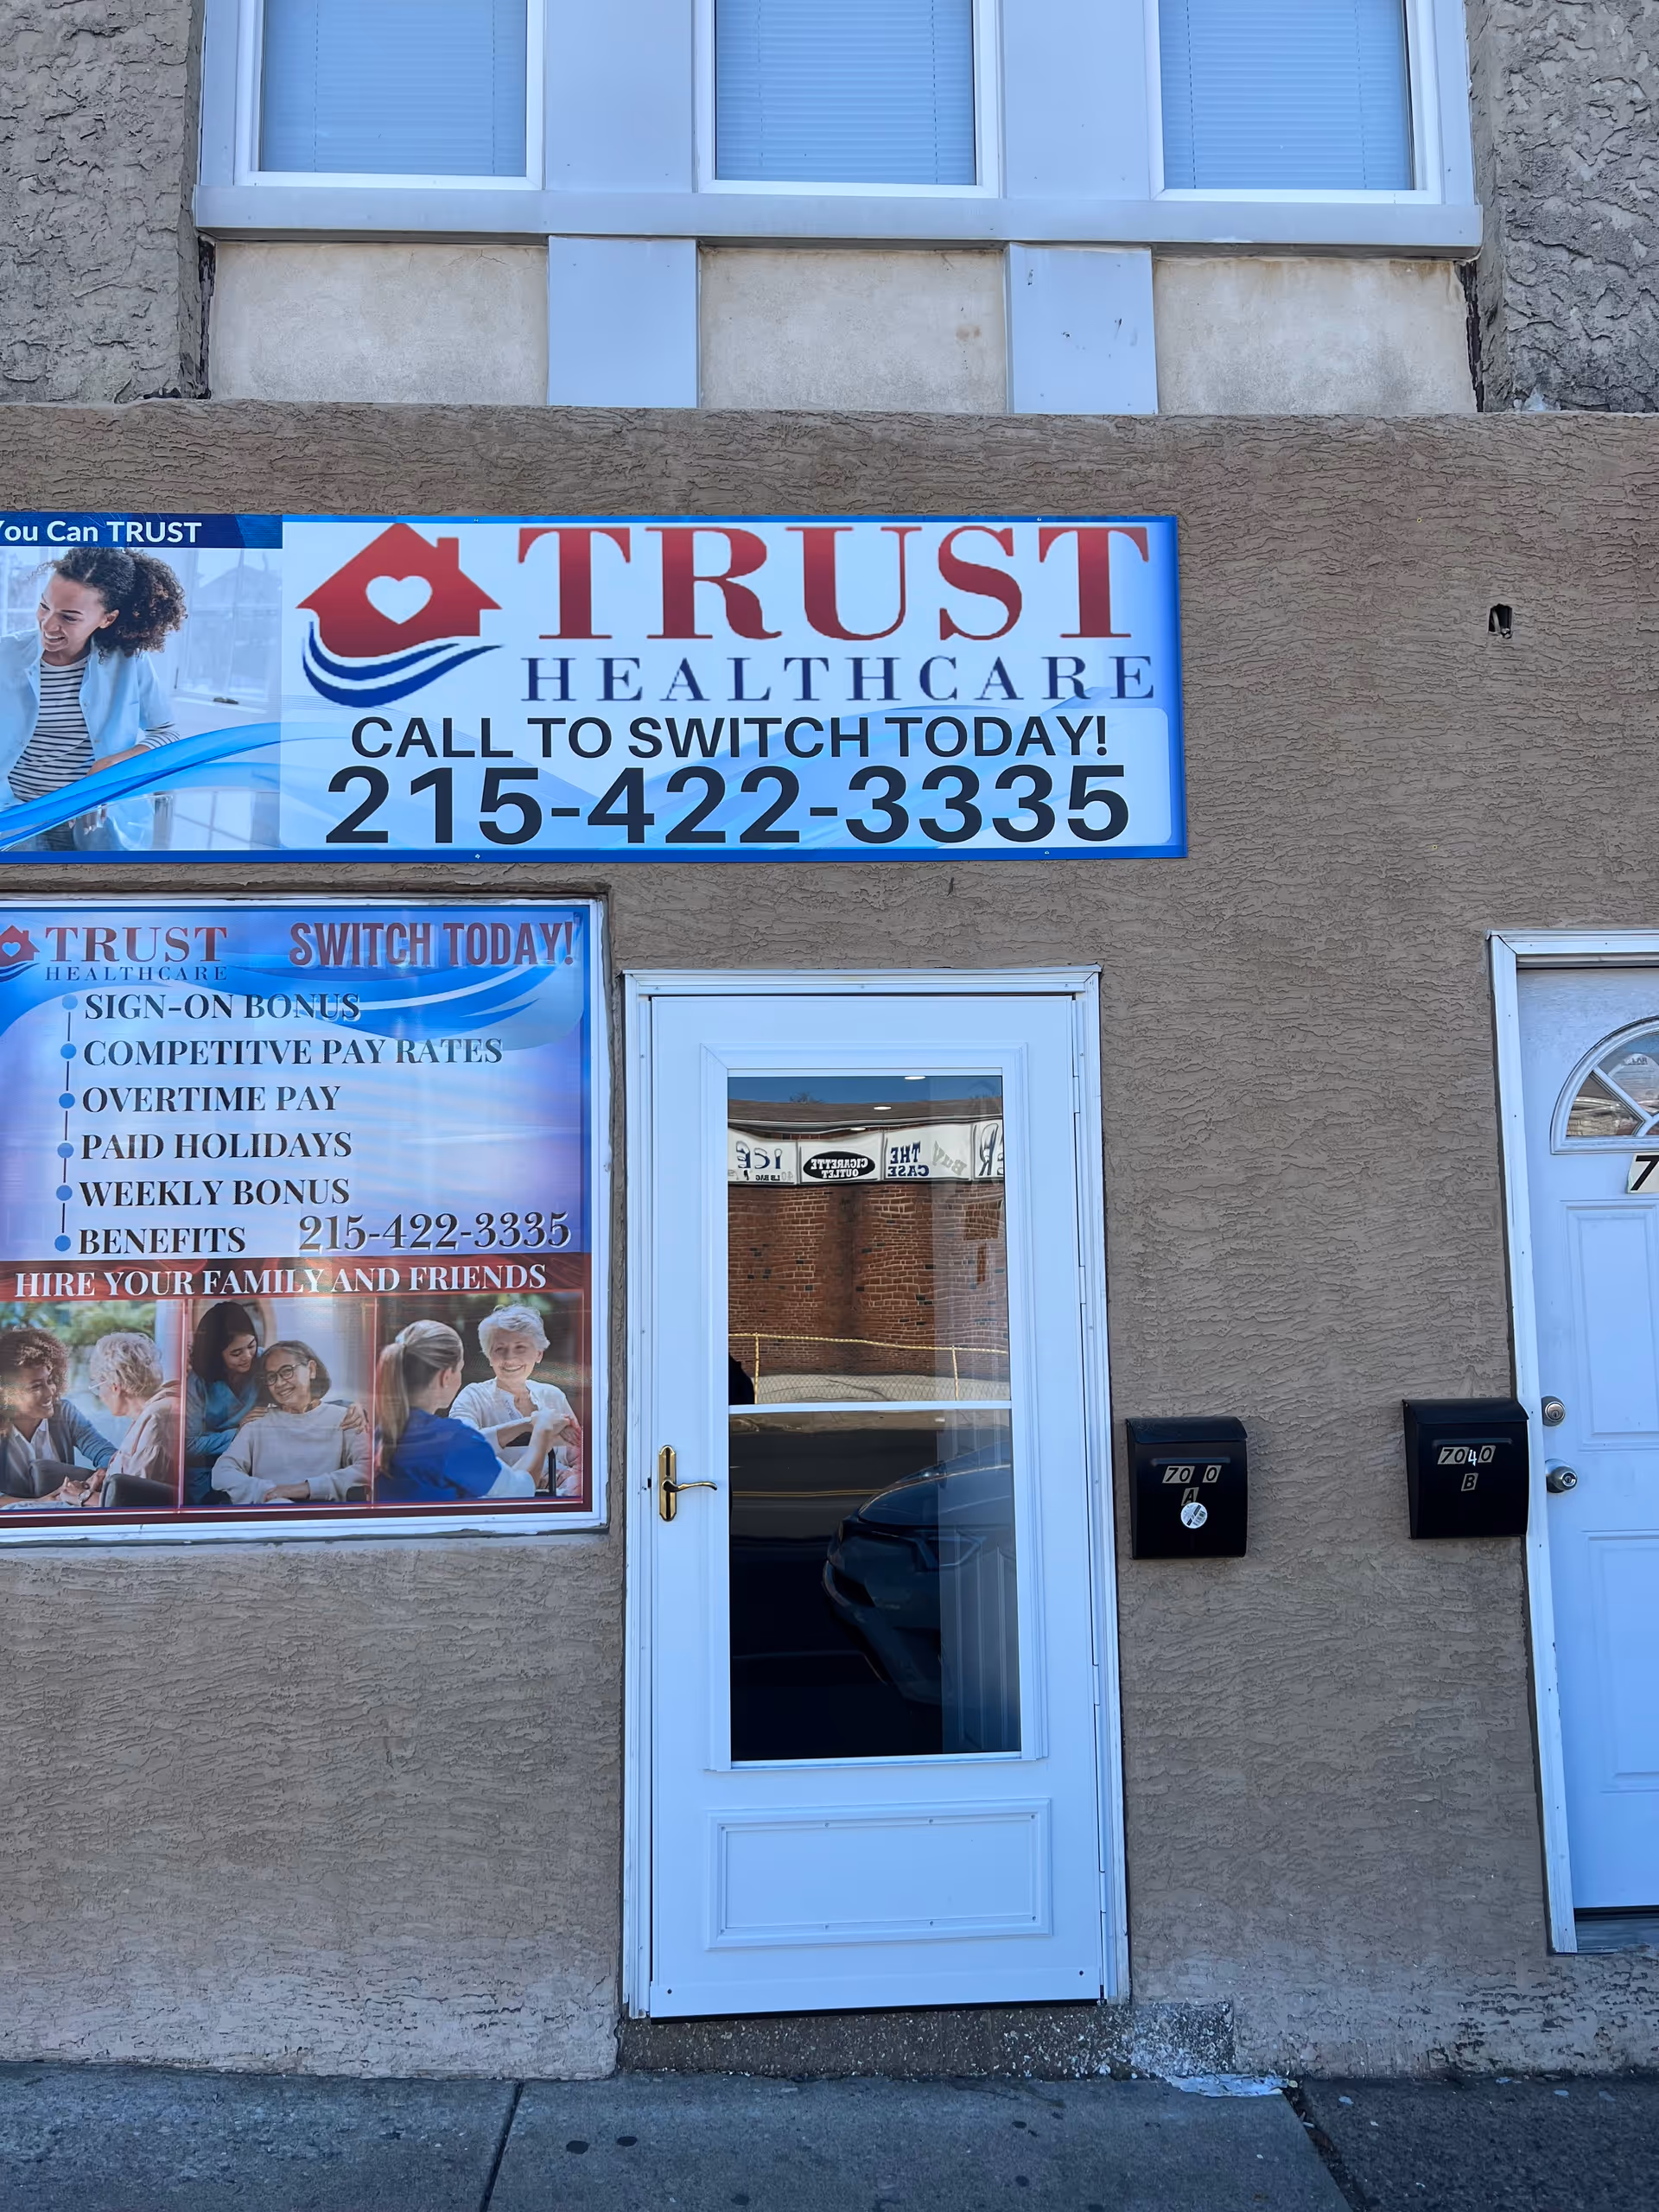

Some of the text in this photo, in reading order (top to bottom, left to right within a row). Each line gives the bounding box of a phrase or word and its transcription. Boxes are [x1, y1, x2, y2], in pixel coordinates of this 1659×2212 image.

[0, 520, 202, 543] ou Can TRUST
[518, 525, 1149, 640] TRUST
[520, 655, 1154, 702] HEALTHCARE
[351, 715, 1108, 758] CALL TO SWITCH TODAY!
[326, 765, 1128, 844] 215-422-3335
[45, 927, 227, 962] TRUST
[289, 921, 574, 966] SWITCH TODAY!
[45, 966, 227, 981] HEALTHCARE
[85, 993, 359, 1019] SIGN-ON BONUS
[84, 1038, 503, 1065] COMPETITVE PAY RATES
[82, 1086, 340, 1112] OVERTIME PAY
[81, 1132, 352, 1159] PAID HOLIDAYS
[79, 1178, 350, 1206] WEEKLY BONUS
[79, 1227, 246, 1254] BENEFITS
[299, 1211, 570, 1250] 215-422-3335
[16, 1264, 546, 1297] HIRE YOUR FAMILY AND FRIENDS
[1440, 1447, 1492, 1465] 7040
[1463, 1474, 1477, 1491] B
